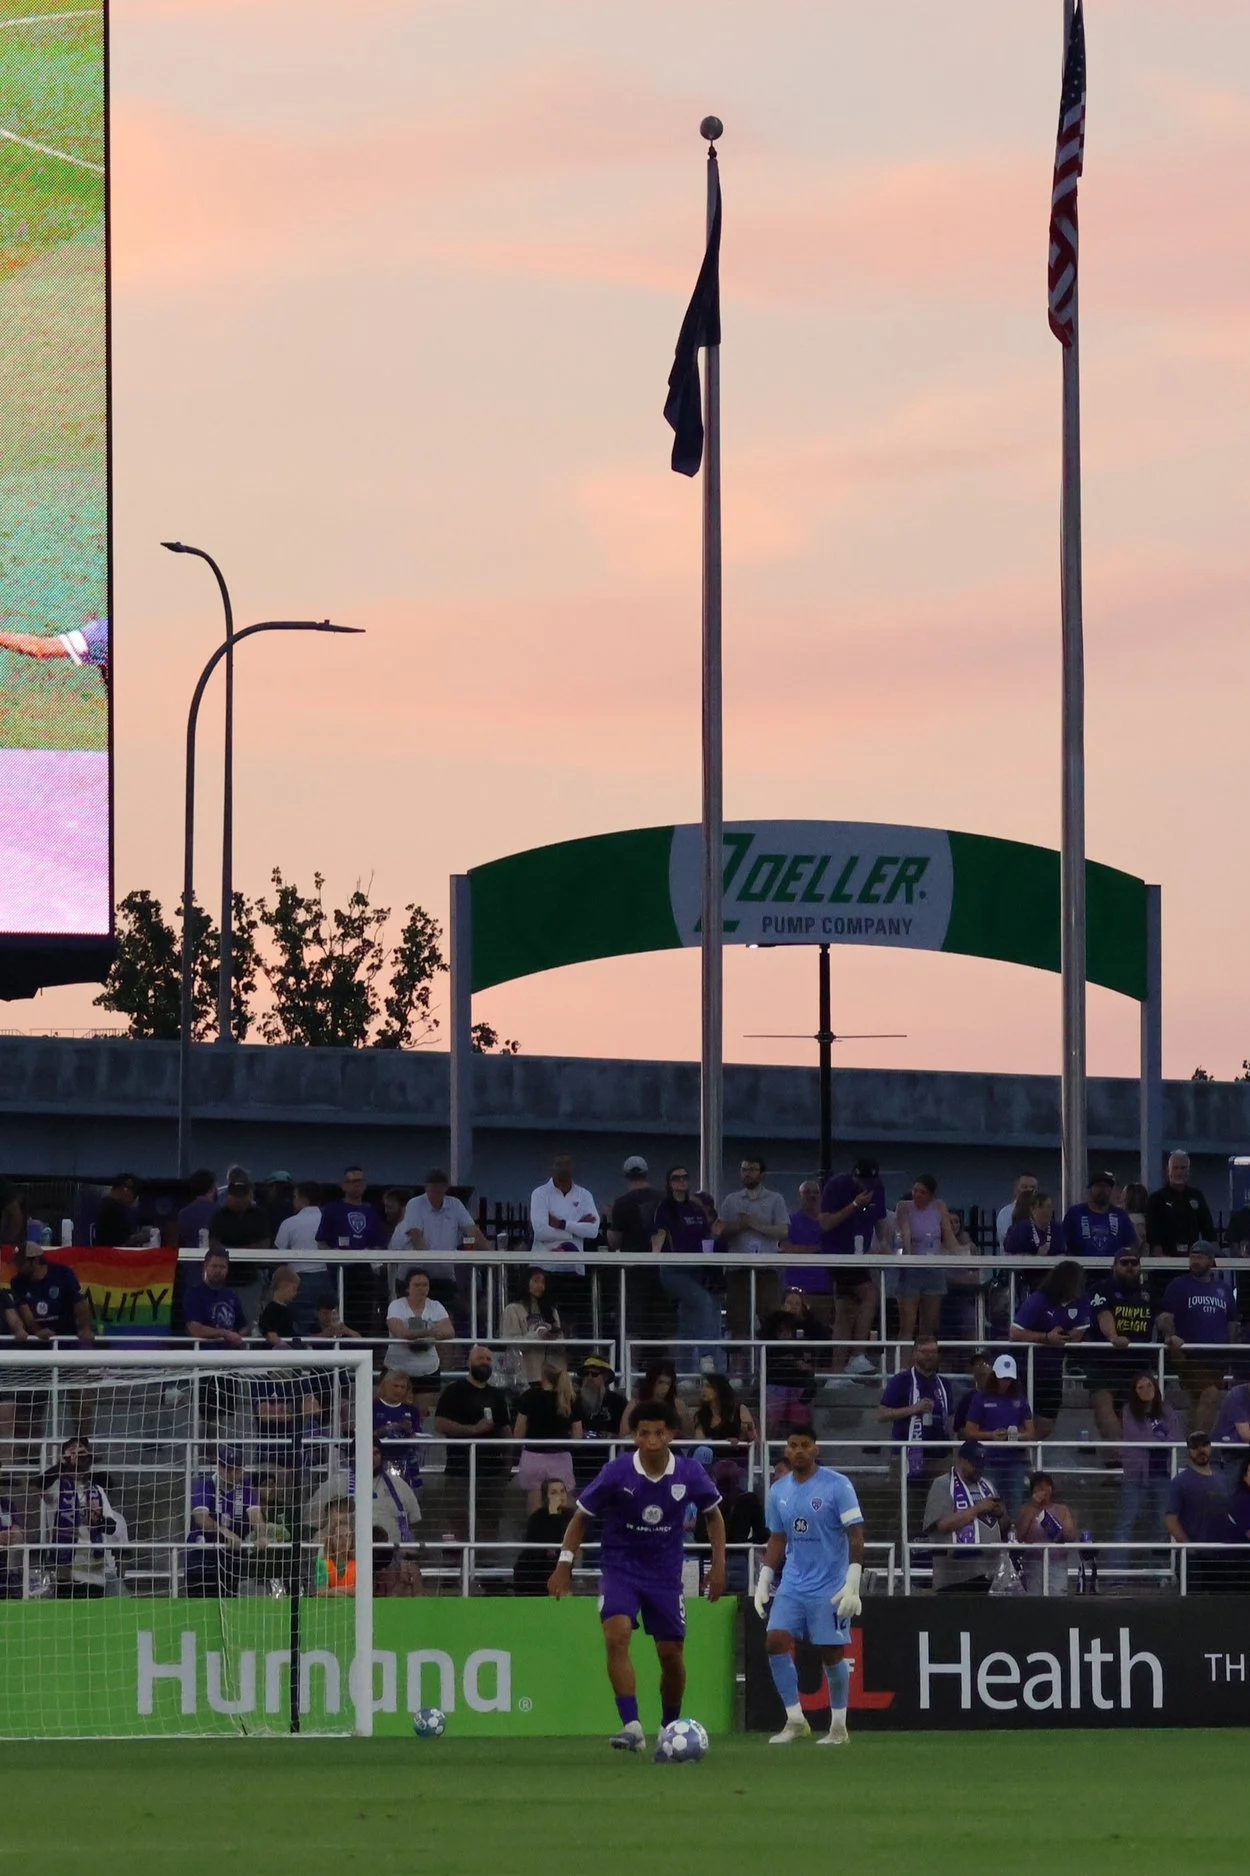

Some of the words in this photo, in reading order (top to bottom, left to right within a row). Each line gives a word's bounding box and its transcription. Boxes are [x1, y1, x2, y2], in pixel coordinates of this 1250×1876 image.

[761, 916, 815, 934] PUMP
[822, 916, 913, 936] COMPANY
[1202, 1305, 1216, 1314] CITY
[137, 1631, 511, 1714] Humana
[919, 1627, 1163, 1711] Health
